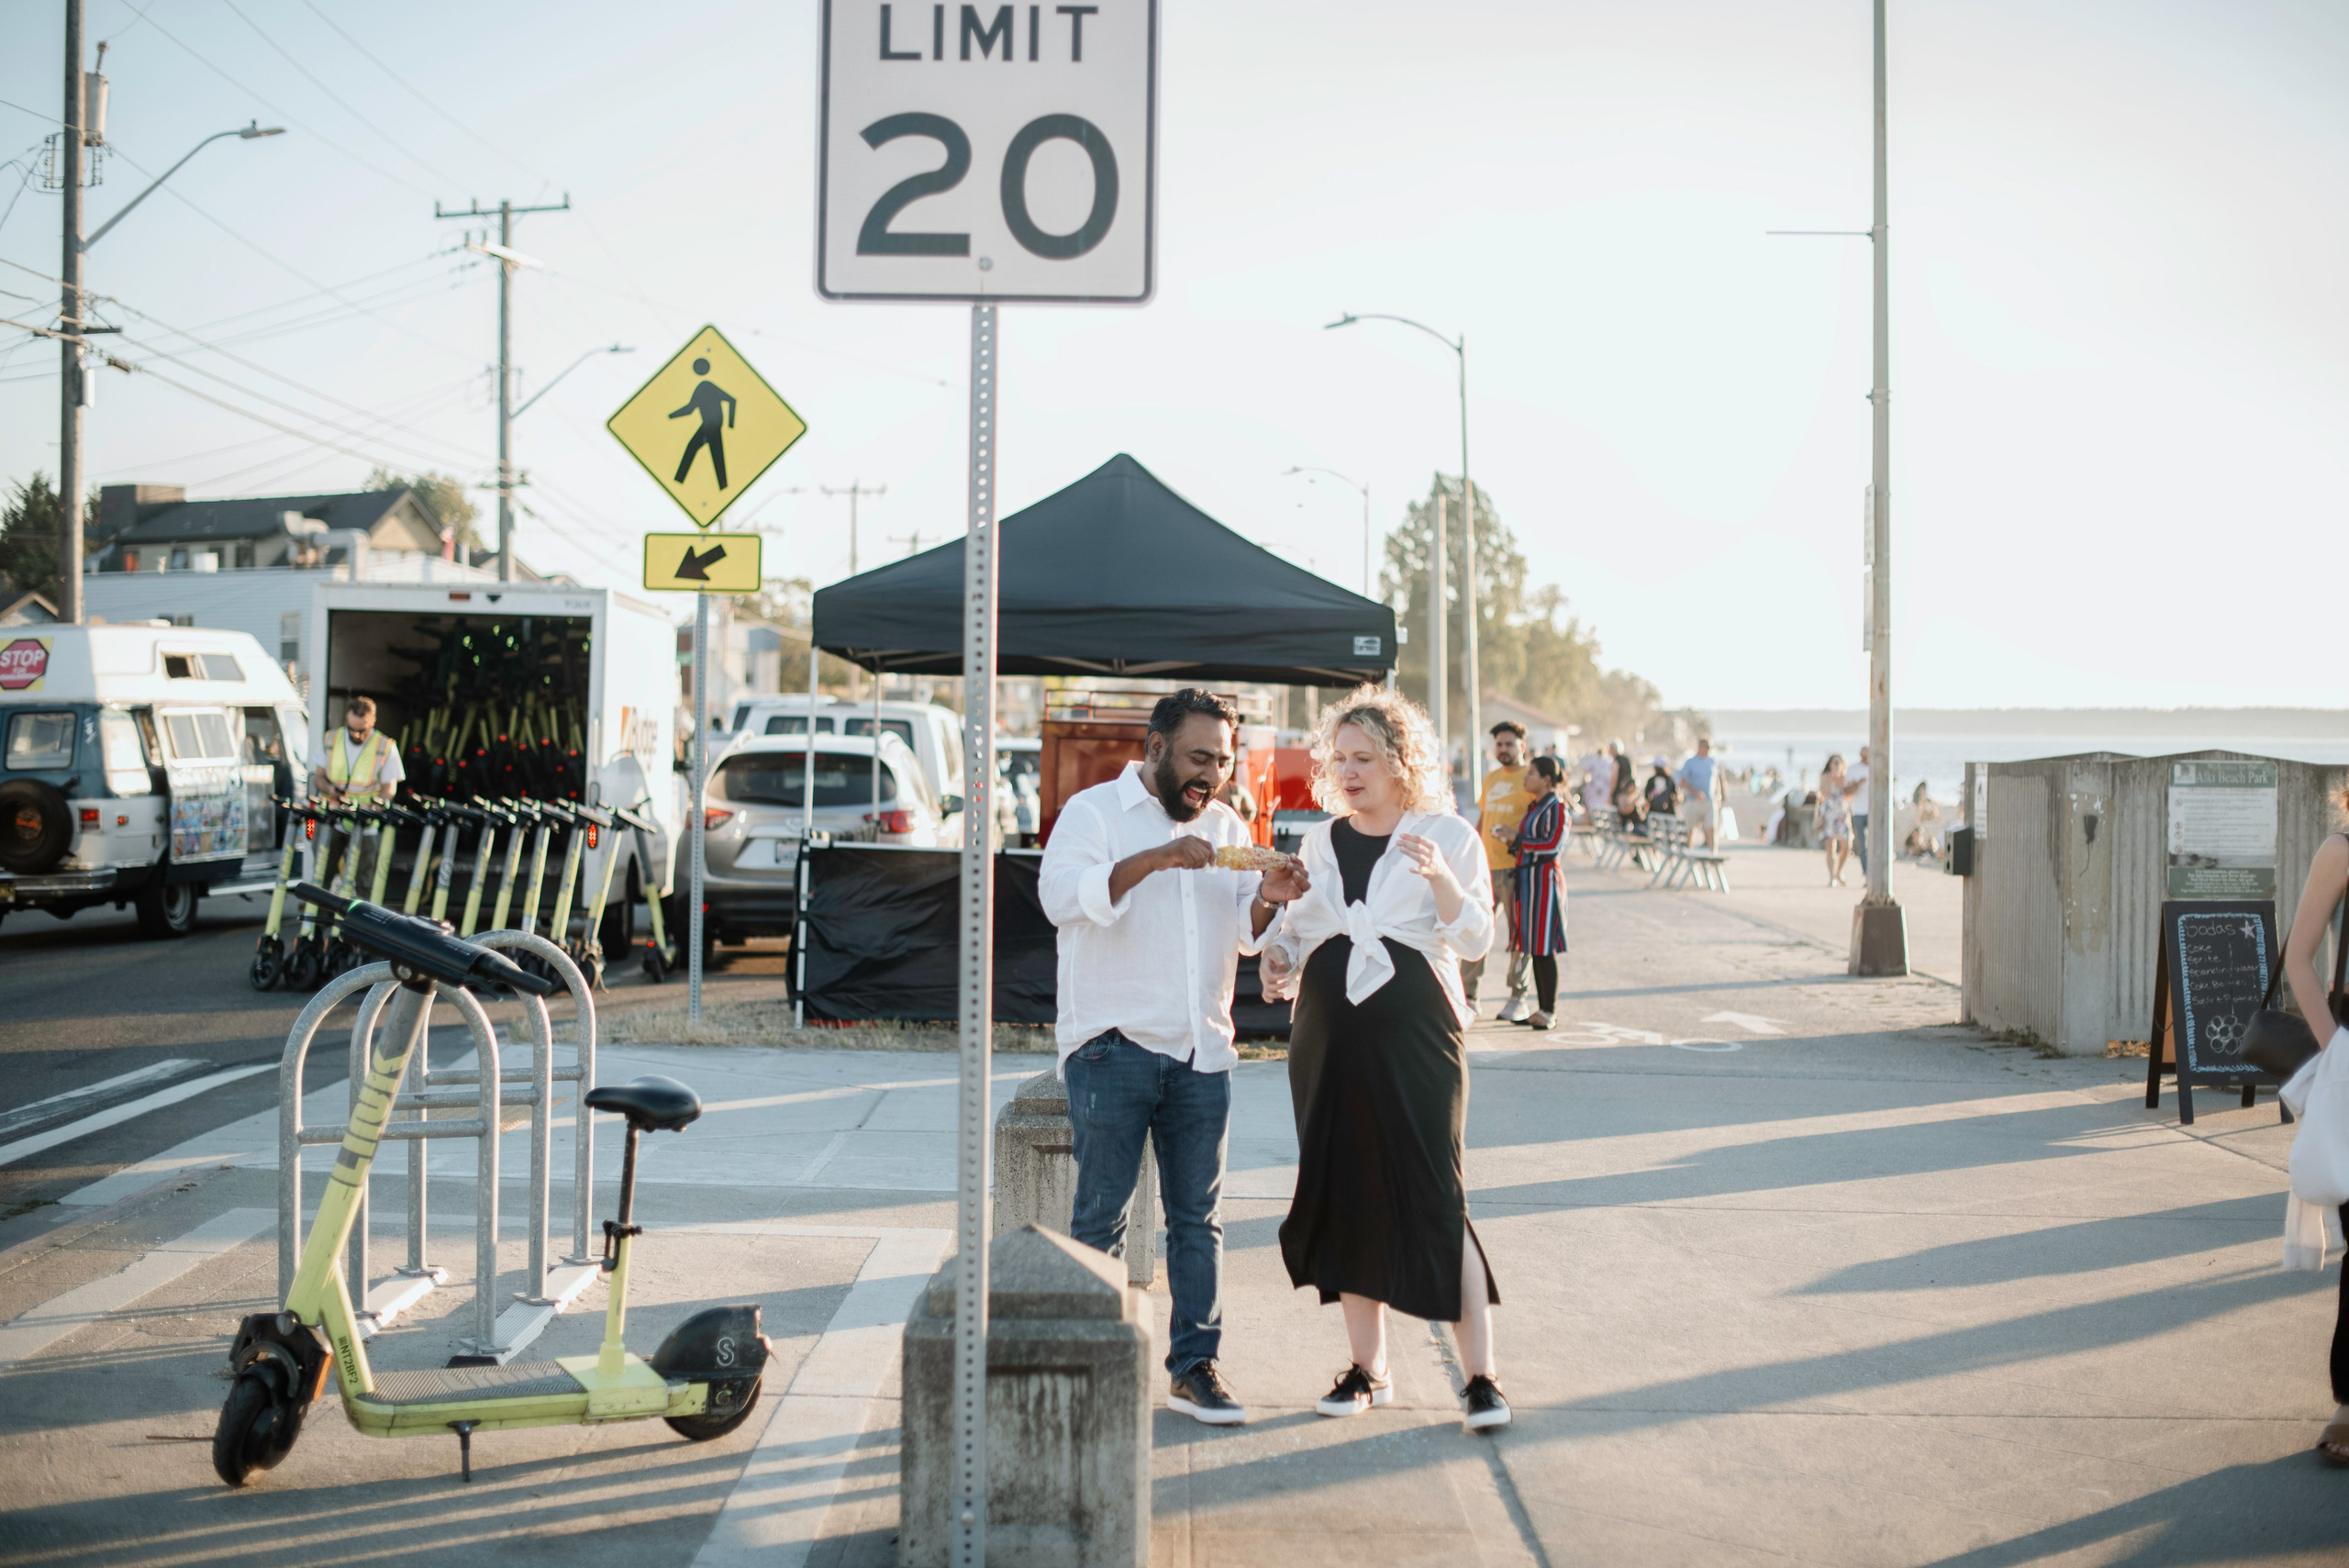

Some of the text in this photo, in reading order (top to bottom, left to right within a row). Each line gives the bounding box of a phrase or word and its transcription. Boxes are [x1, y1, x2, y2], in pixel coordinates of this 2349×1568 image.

[879, 4, 1098, 62] LIMIT
[856, 111, 1119, 261] 20
[0, 649, 46, 668] STOP
[2196, 771, 2269, 784] Alki Beach Park
[2188, 944, 2212, 953] Coke
[2188, 955, 2221, 968] Sprite
